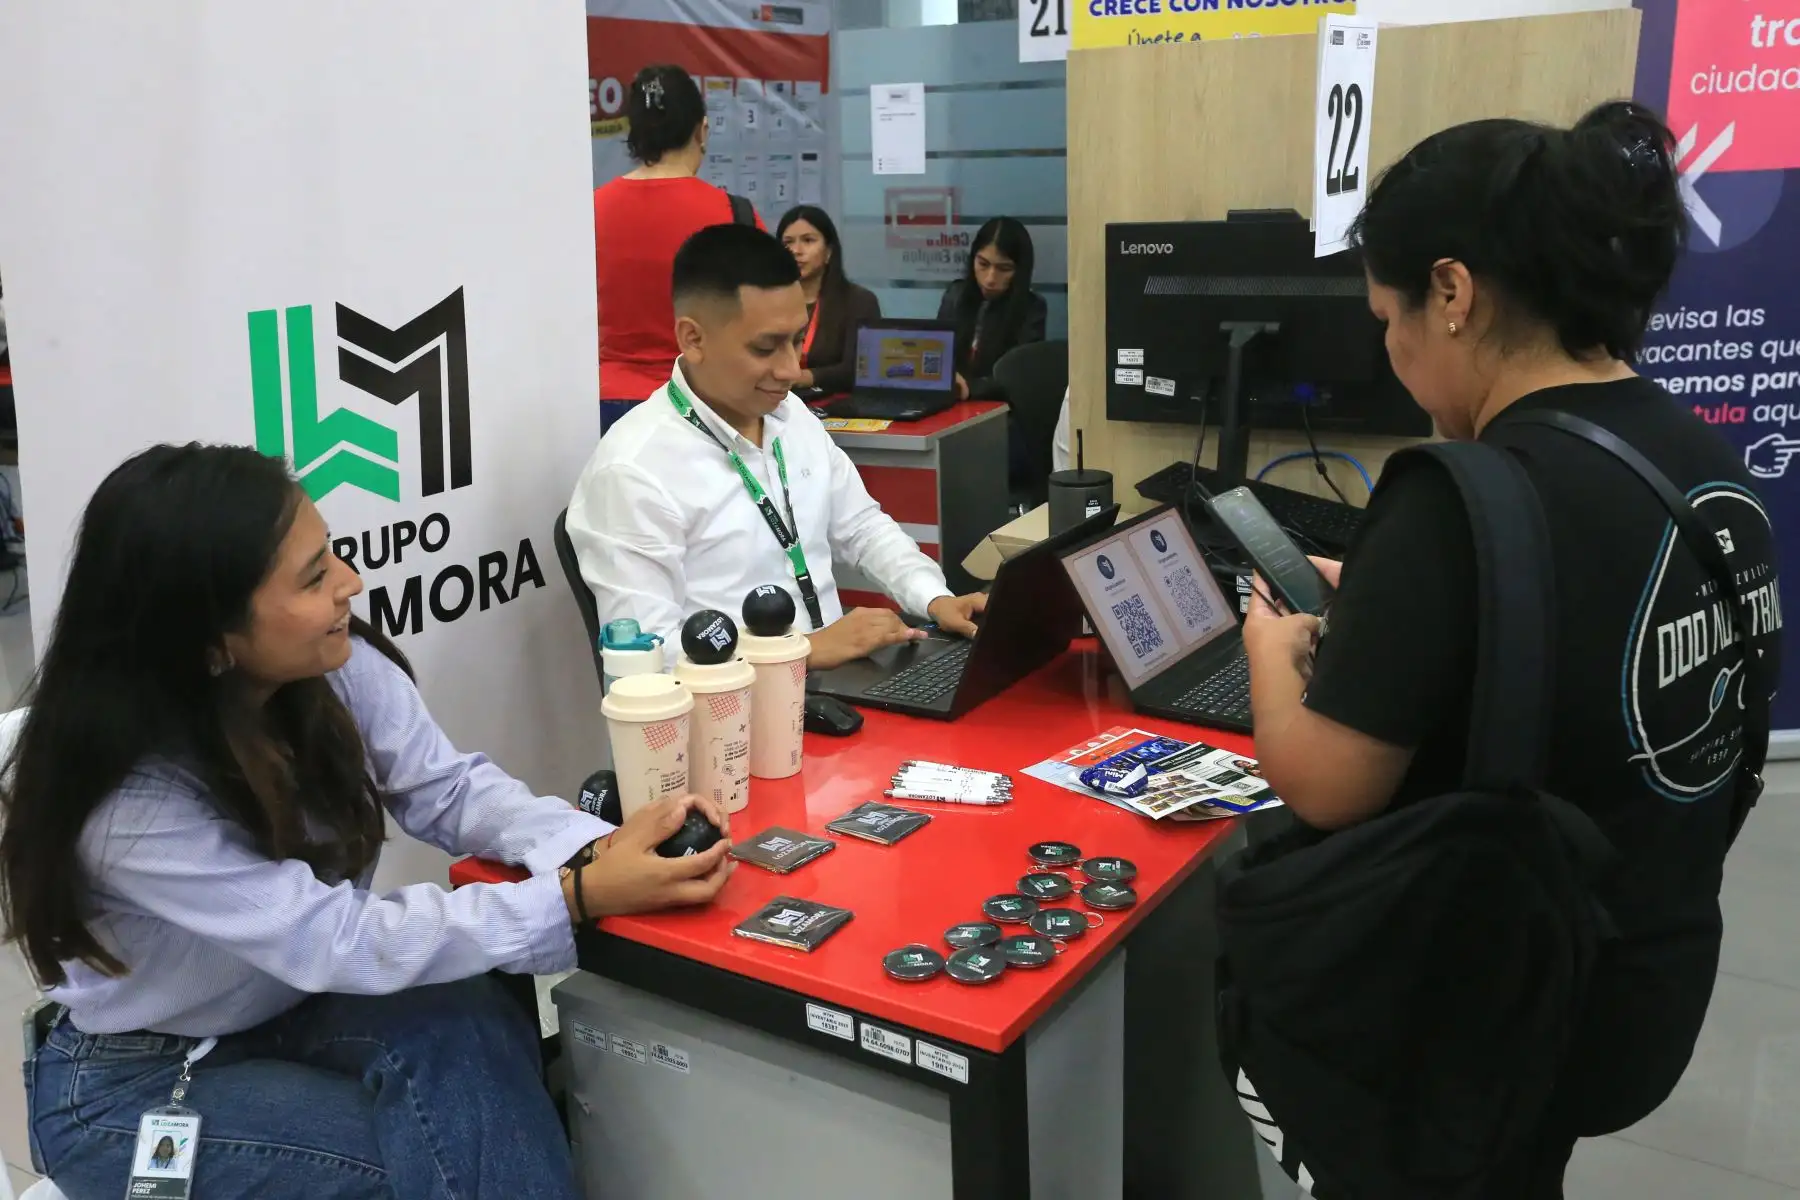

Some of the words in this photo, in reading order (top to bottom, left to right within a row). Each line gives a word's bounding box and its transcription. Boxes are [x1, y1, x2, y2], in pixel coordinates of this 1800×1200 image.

[1030, 0, 1067, 37] 21
[1089, 0, 1162, 16] CRECE
[1169, 0, 1219, 12] CON
[1326, 83, 1364, 198] 22
[1120, 241, 1174, 255] Lenovo
[1726, 304, 1765, 327] las
[1635, 340, 1754, 365] vacantes
[1760, 339, 1800, 364] qu
[1653, 374, 1746, 394] emos
[1751, 371, 1800, 398] par
[1692, 402, 1746, 424] ula
[332, 512, 450, 575] RUPO
[369, 537, 546, 637] MORA
[695, 616, 725, 640] LOZAMORA
[594, 789, 608, 817] ZAMORA
